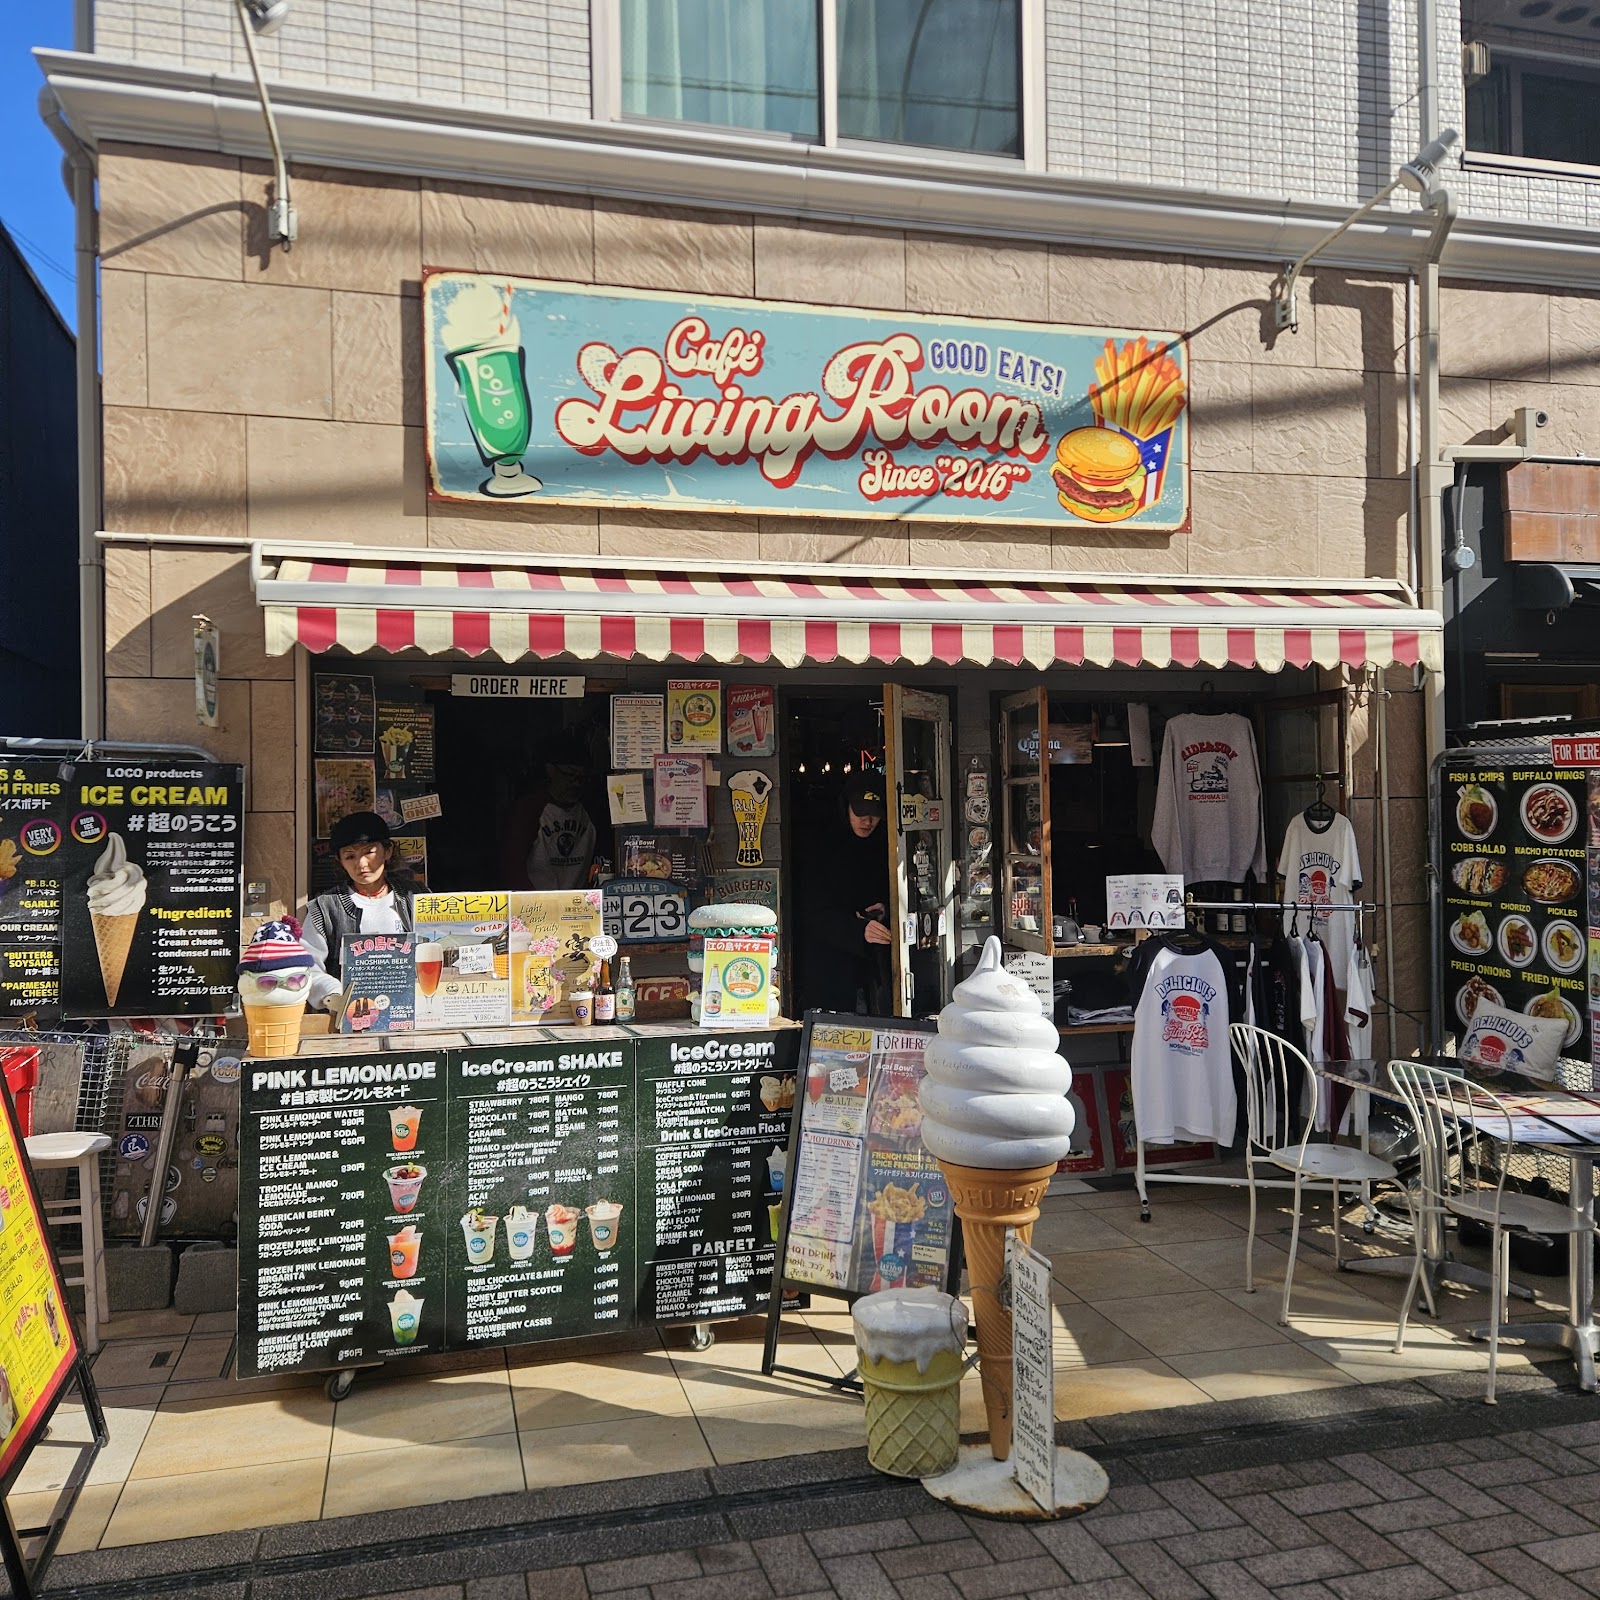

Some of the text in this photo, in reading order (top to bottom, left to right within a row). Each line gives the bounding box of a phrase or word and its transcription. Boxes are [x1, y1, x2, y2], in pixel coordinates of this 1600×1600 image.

[667, 316, 767, 377] Café
[929, 340, 1064, 397] GOOD EATS!
[555, 332, 1051, 489] Living Room
[859, 449, 935, 501] Since
[470, 678, 568, 696] ORDER HERE
[1554, 743, 1600, 760] FOR HERE
[107, 768, 203, 779] LOCO products
[1449, 772, 1505, 782] FISH & CHIPS
[1513, 771, 1585, 781] BUFFALO WINGS
[12, 783, 60, 795] FRIES
[81, 786, 228, 806] ICE CREAM
[0, 798, 51, 810] イスポテト
[402, 796, 438, 810] CASH
[734, 800, 757, 812] ALL
[405, 805, 439, 820] ONLY
[903, 805, 917, 819] OPEN
[80, 817, 94, 825] RICH
[27, 827, 52, 840] VERY
[80, 828, 100, 837] CREAM
[739, 822, 760, 842] NEED
[29, 837, 54, 846] POPULAR
[1451, 843, 1506, 854] COBB SALAD
[738, 849, 762, 863] BEER
[1515, 847, 1585, 858] NACHO POTATOES
[613, 884, 645, 892] TODAY
[716, 880, 772, 899] BURGERS
[417, 896, 508, 915] 鎌倉ビール
[520, 902, 543, 917] Light
[1500, 902, 1531, 913] CHORIZO
[1548, 907, 1578, 917] PICKLES
[529, 912, 546, 923] and
[158, 928, 218, 936] Fresh cream
[534, 923, 559, 935] Fruity
[158, 938, 224, 946] Cream cheese
[350, 936, 411, 956] 江の島ビール
[707, 941, 769, 950] 江の島サイダー
[158, 948, 232, 958] condensed milk
[9, 959, 59, 967] SOYSAUCE
[158, 965, 195, 974] 生クリーム
[1451, 960, 1511, 978] FRIED ONIONS
[6, 982, 58, 990] PARMESAN
[158, 976, 205, 984] クリームチーズ
[1521, 972, 1585, 991] FRIED WINGS
[22, 989, 58, 997] CHEESE
[462, 983, 487, 994] ALT
[813, 1029, 871, 1046] 鎌倉ビール
[1473, 1015, 1533, 1049] DELICIOUS
[877, 1035, 927, 1050] FOR HERE
[670, 1040, 775, 1062] IceCream
[462, 1051, 623, 1077] IceCream SHAKE
[252, 1062, 436, 1091] PINK LEMONADE
[497, 1074, 591, 1092] #超のうこうシェイク
[280, 1085, 410, 1106] #自家製ピンクレモネード
[469, 1095, 549, 1108] STRAWBERRY 780円
[834, 1096, 853, 1105] ALT
[260, 1109, 364, 1124] PINK LEMONADE WATER
[260, 1129, 357, 1144] PINK LEMONADE SODA
[661, 1122, 786, 1142] Drink & IceCream Float
[469, 1139, 562, 1153] KINAKO soybeanpowder
[811, 1135, 855, 1148] HOT DRINKS
[872, 1152, 902, 1160] FRENCH
[259, 1180, 338, 1193] TROPICAL MANGO
[468, 1176, 504, 1185] Espresso
[259, 1190, 307, 1201] LEMONADE
[259, 1209, 335, 1223] AMERICAN BERRY
[258, 1234, 366, 1252] FROZEN PINK LEMONADE
[692, 1238, 756, 1256] PARFET
[258, 1257, 366, 1276] FROZEN PINK LEMONADE
[258, 1272, 305, 1284] MRGARITA
[467, 1285, 562, 1302] HONEY BUTTER SCOTCH
[258, 1292, 361, 1311] PINK LEMONADE W/ACL
[656, 1297, 744, 1312] KINAKO soybeanpowder
[467, 1305, 527, 1318] KALUA MANGO
[468, 1318, 552, 1335] STRAWBERRY CASSIS
[258, 1328, 353, 1346] AMERICAN LEMONADE
[258, 1339, 329, 1353] REDWINE FLOAT
